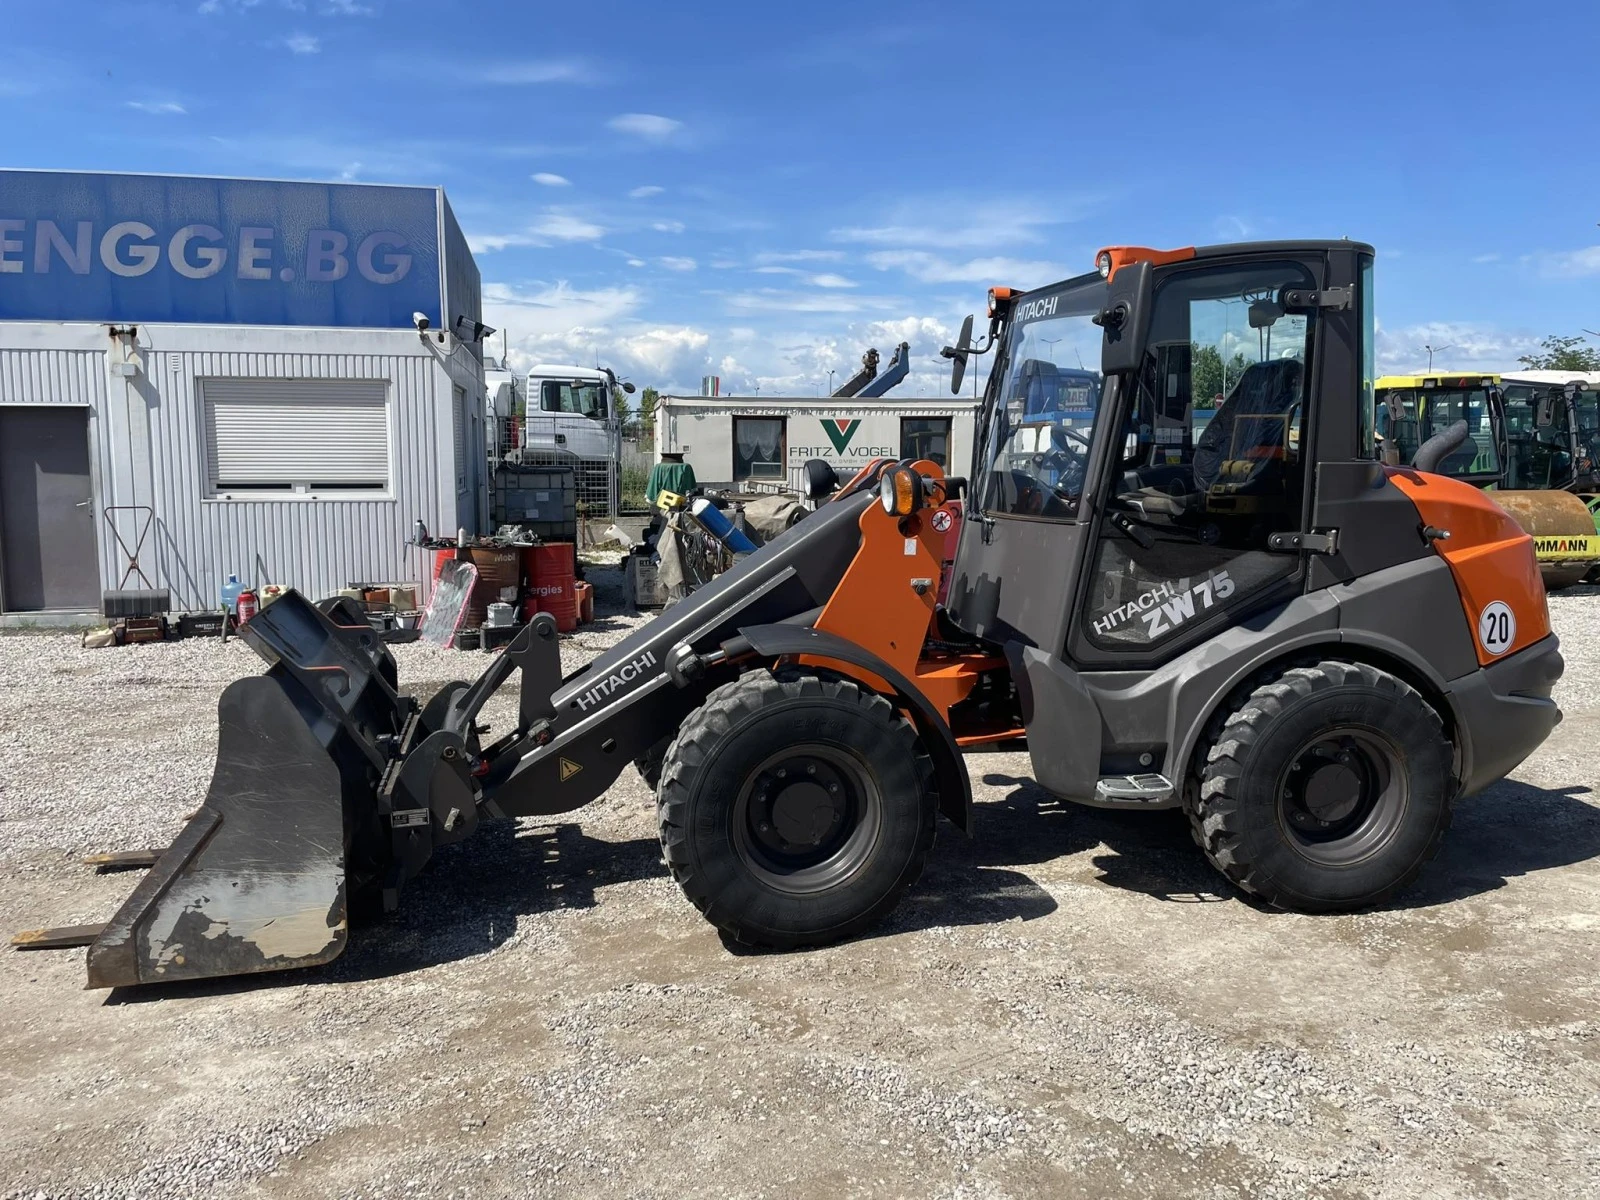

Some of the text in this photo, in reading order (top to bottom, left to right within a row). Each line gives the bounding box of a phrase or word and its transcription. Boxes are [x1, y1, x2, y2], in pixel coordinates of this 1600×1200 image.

[1015, 296, 1059, 324] HITACHI
[789, 446, 898, 457] FRITZ VOGEL
[1534, 539, 1587, 552] MMANN
[528, 585, 563, 597] ergies
[1141, 570, 1236, 640] ZW75
[1092, 580, 1175, 636] HITACHI
[1486, 611, 1509, 644] 20
[576, 650, 657, 711] HITACHI
